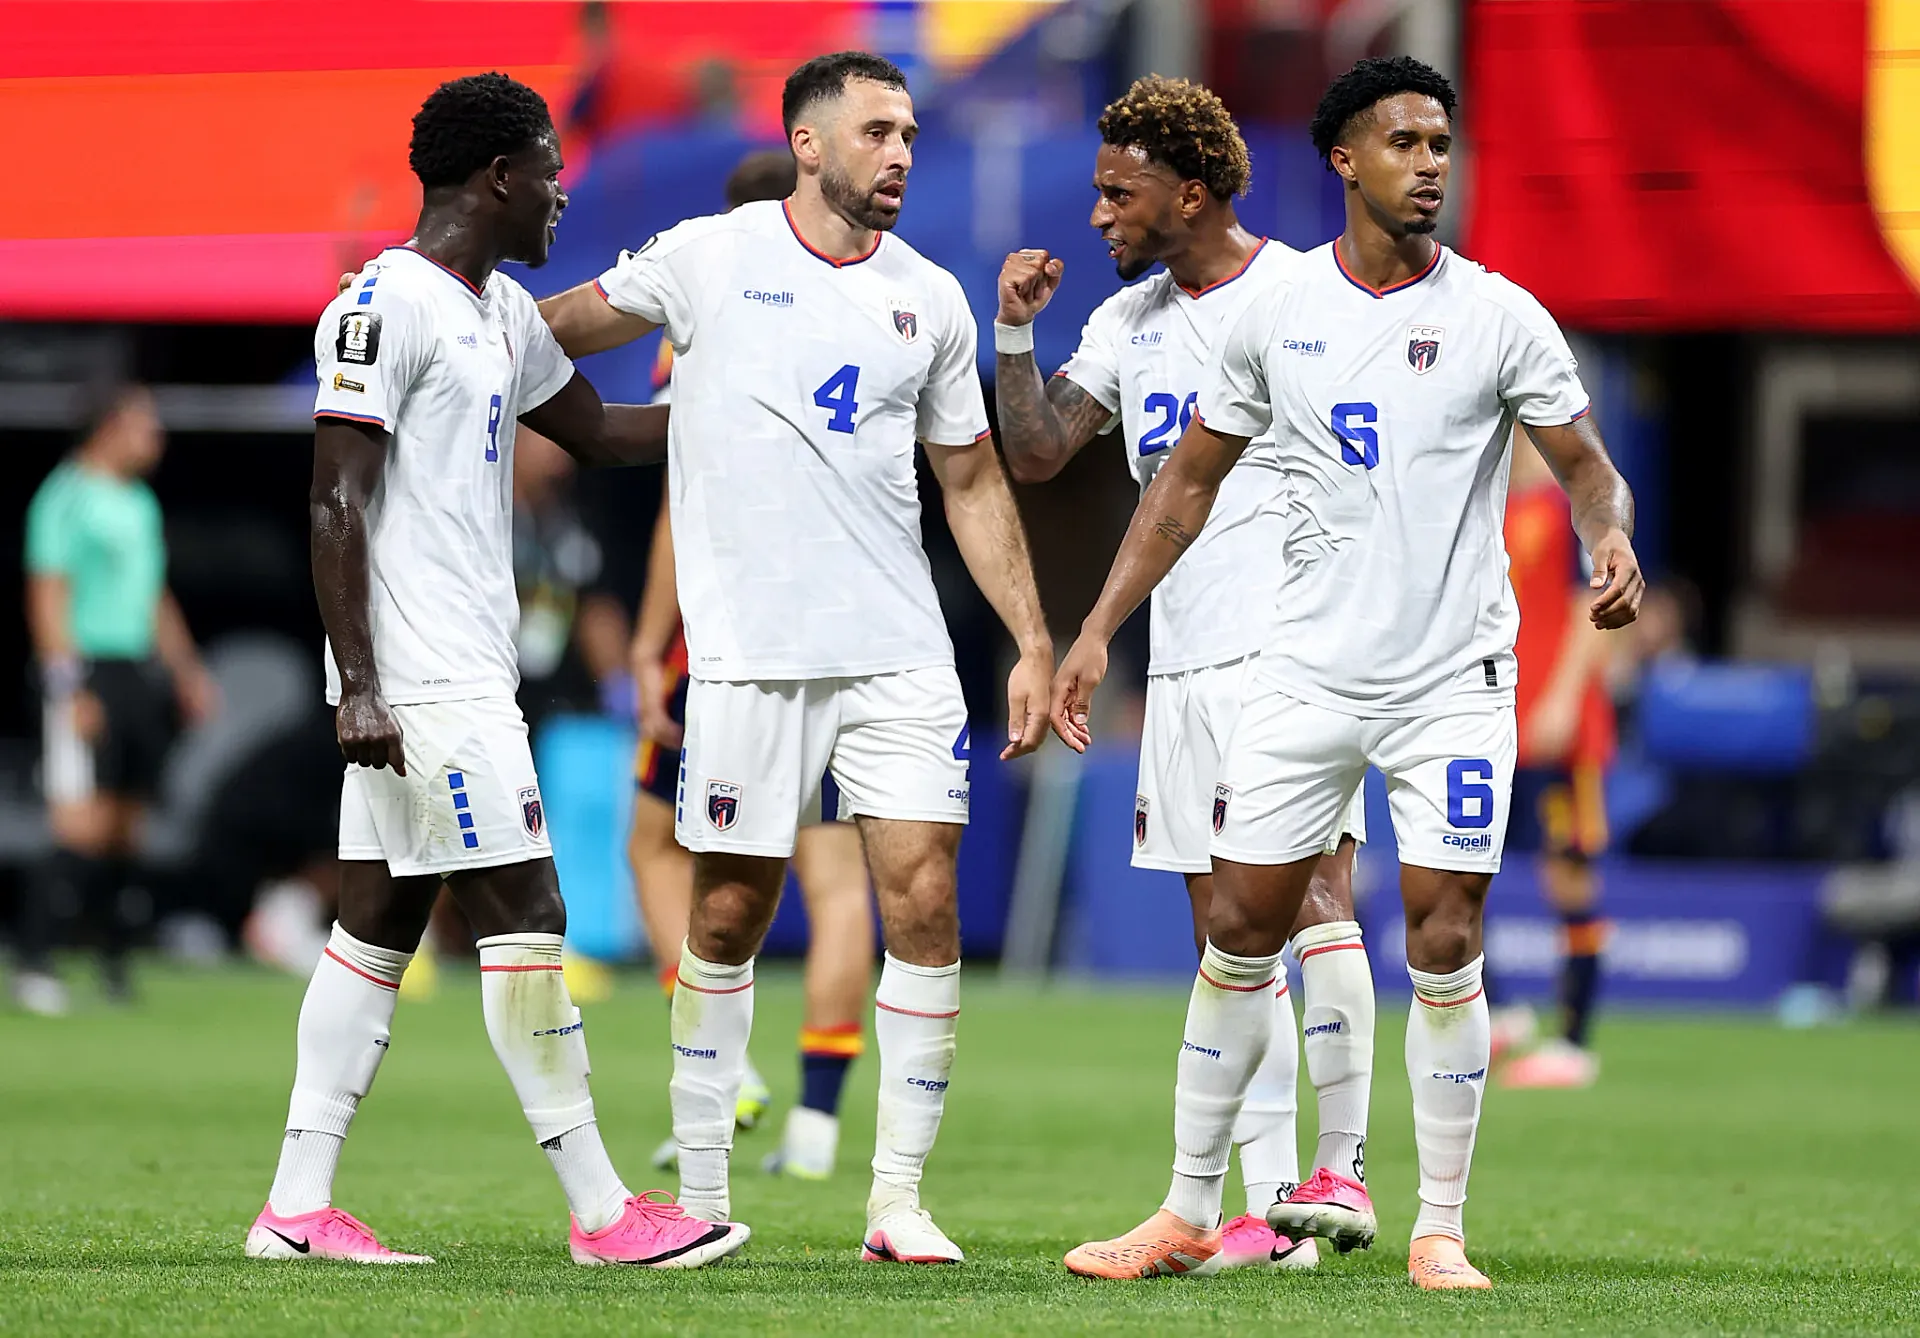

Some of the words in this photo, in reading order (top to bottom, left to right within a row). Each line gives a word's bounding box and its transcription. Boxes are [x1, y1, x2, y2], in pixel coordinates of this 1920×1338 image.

[743, 290, 794, 304] capelli
[1410, 327, 1442, 336] FCF
[813, 364, 860, 434] 4
[1331, 402, 1379, 470] 6
[520, 788, 537, 800] FCF
[710, 783, 739, 793] FCF
[1446, 759, 1493, 828] 6
[1442, 834, 1492, 850] capelli
